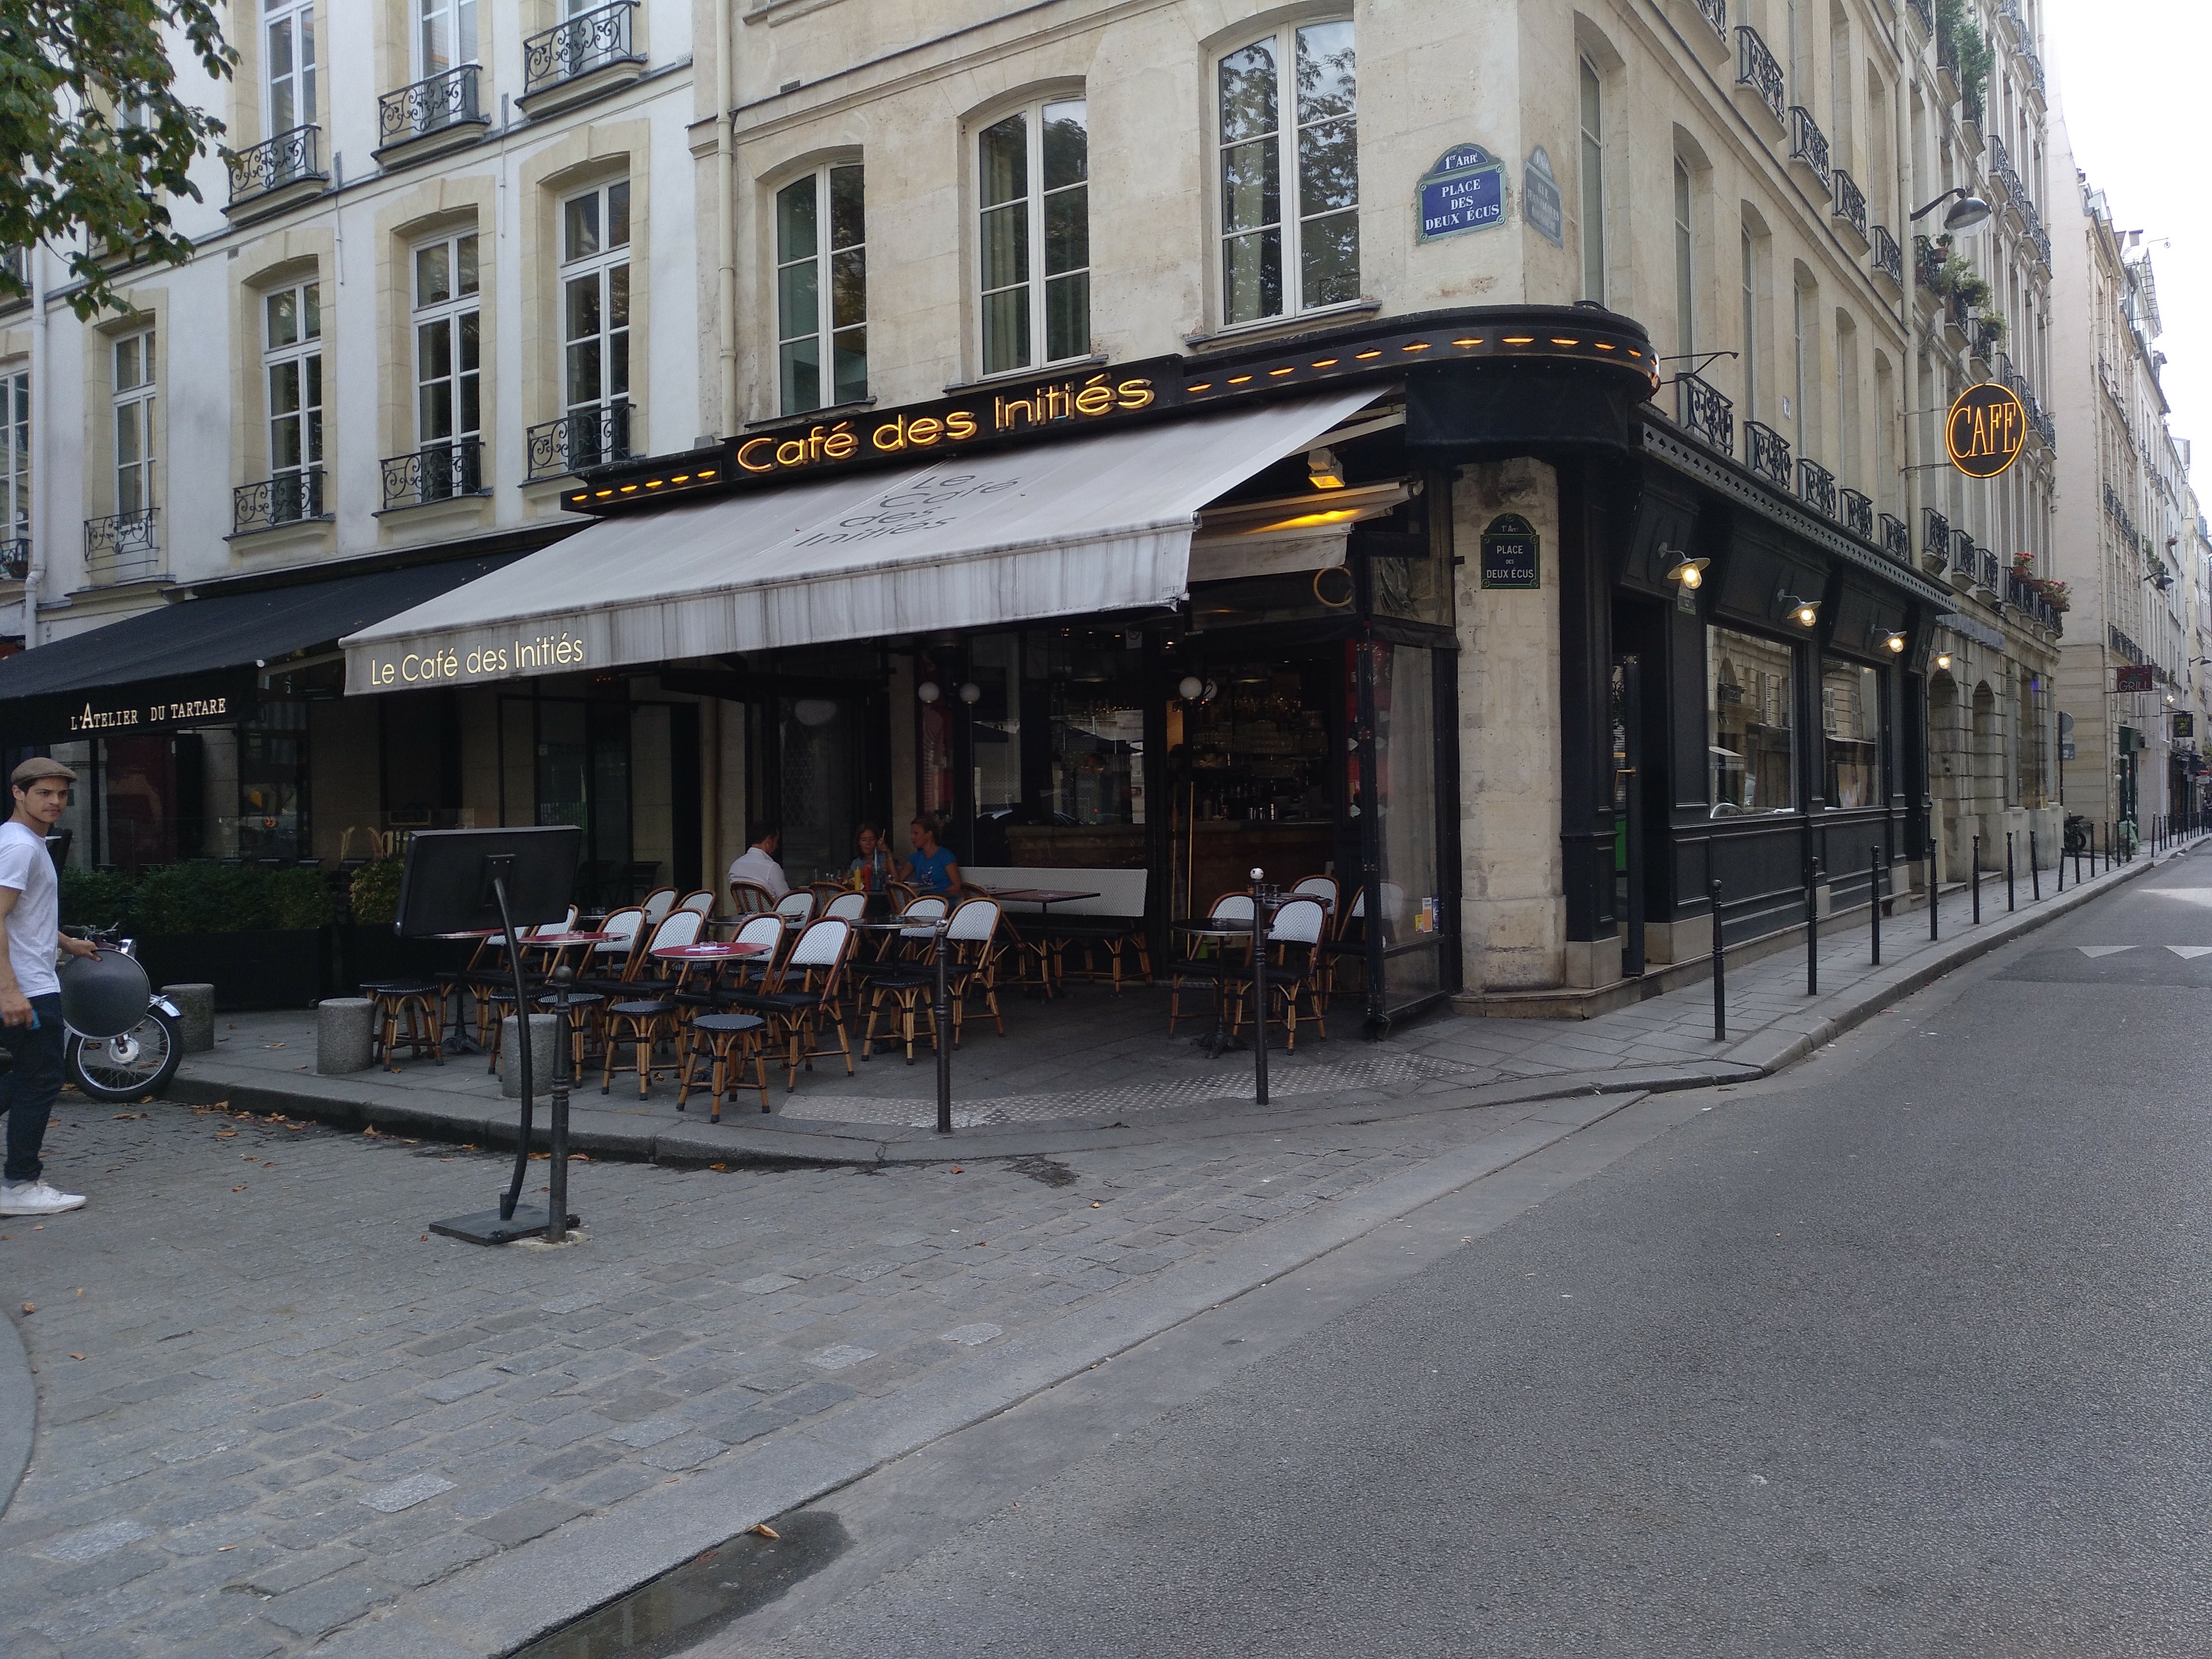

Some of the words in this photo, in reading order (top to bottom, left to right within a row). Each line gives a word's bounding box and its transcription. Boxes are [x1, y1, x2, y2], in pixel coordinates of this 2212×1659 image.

[1442, 179, 1480, 197] PLACE
[1451, 196, 1473, 210] DES
[1425, 213, 1460, 230] DEUX
[1467, 204, 1499, 221] ÉCUS
[737, 421, 859, 472] Café
[873, 411, 977, 451] des
[996, 373, 1155, 432] Initiés
[1950, 402, 2016, 458] CAFE
[879, 477, 1022, 508] Café
[911, 475, 976, 490] Le
[839, 506, 943, 528] des
[793, 517, 958, 547] Initiés
[1496, 545, 1523, 554] PLACE
[1486, 569, 1509, 578] DEUX
[1511, 567, 1534, 578] ÉCUS
[372, 659, 395, 685] Le
[401, 647, 458, 682] Café
[466, 644, 507, 674] des
[514, 632, 584, 669] Initiés
[2119, 680, 2151, 691] GRILL
[150, 705, 166, 721] DU
[170, 698, 226, 719] TARTARE
